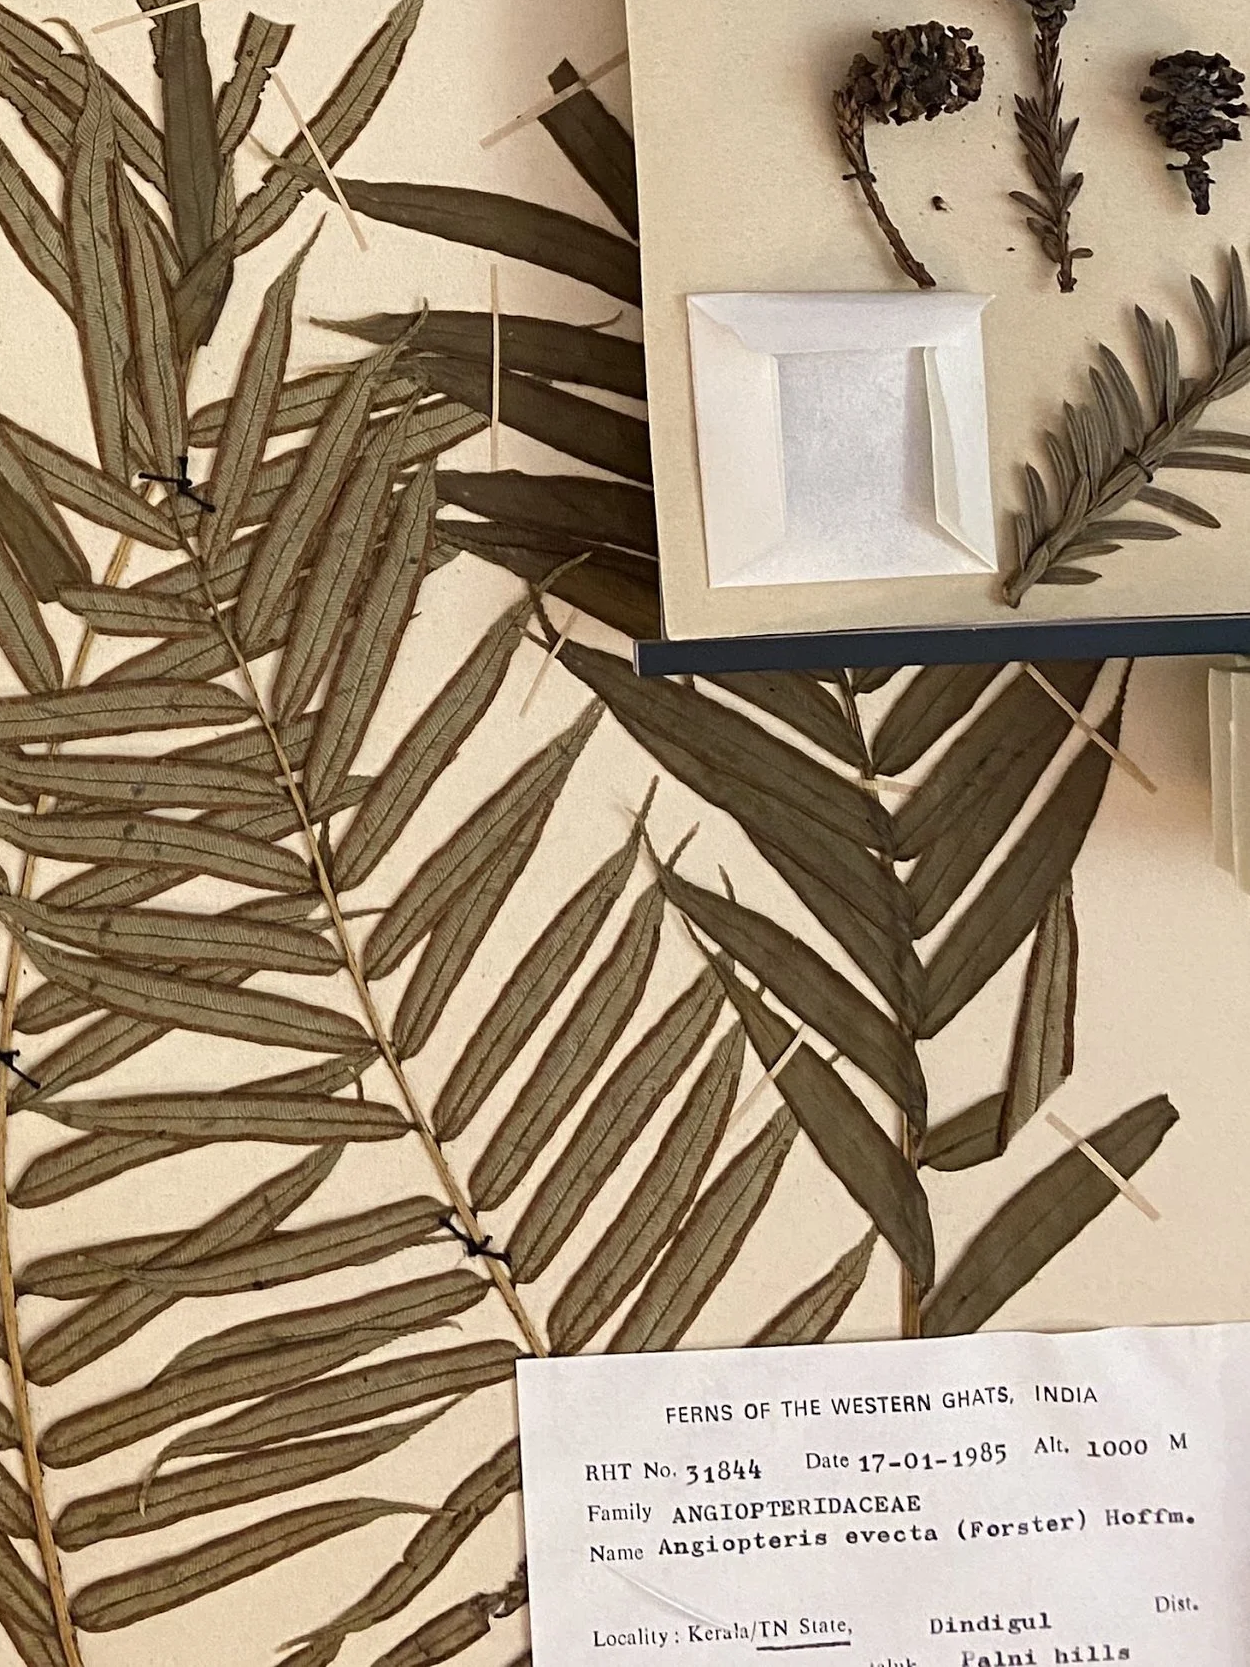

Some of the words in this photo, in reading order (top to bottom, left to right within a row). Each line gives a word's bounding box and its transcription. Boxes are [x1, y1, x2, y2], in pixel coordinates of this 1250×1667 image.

[666, 1404, 733, 1424] FERNS
[744, 1402, 770, 1420] OF
[780, 1399, 821, 1418] THE
[830, 1393, 931, 1415] WESTERN
[942, 1386, 1014, 1409] GHATS,
[1035, 1385, 1098, 1404] INDIA
[805, 1452, 850, 1470] Date
[858, 1441, 1007, 1474] 17-01-1985
[1034, 1435, 1069, 1454] Alt.
[1087, 1439, 1148, 1458] 1000
[1169, 1432, 1188, 1450] M
[585, 1462, 632, 1482] RHT
[643, 1461, 677, 1479] No.
[686, 1458, 762, 1486] 31844
[587, 1502, 652, 1523] Family
[672, 1494, 922, 1524] ANGIOPTERIDACEAE
[590, 1545, 644, 1563] Name
[658, 1529, 827, 1558] Angiopteris
[845, 1524, 938, 1545] evecta
[957, 1508, 1086, 1541] (Forster)
[1105, 1508, 1195, 1527] Hoffm.
[1155, 1596, 1199, 1613] Dist.
[688, 1619, 789, 1643] Kerala/TN
[799, 1617, 852, 1635] State,
[930, 1612, 1052, 1635] Dindigul
[962, 1648, 1037, 1667] Palni
[1054, 1644, 1130, 1664] hills
